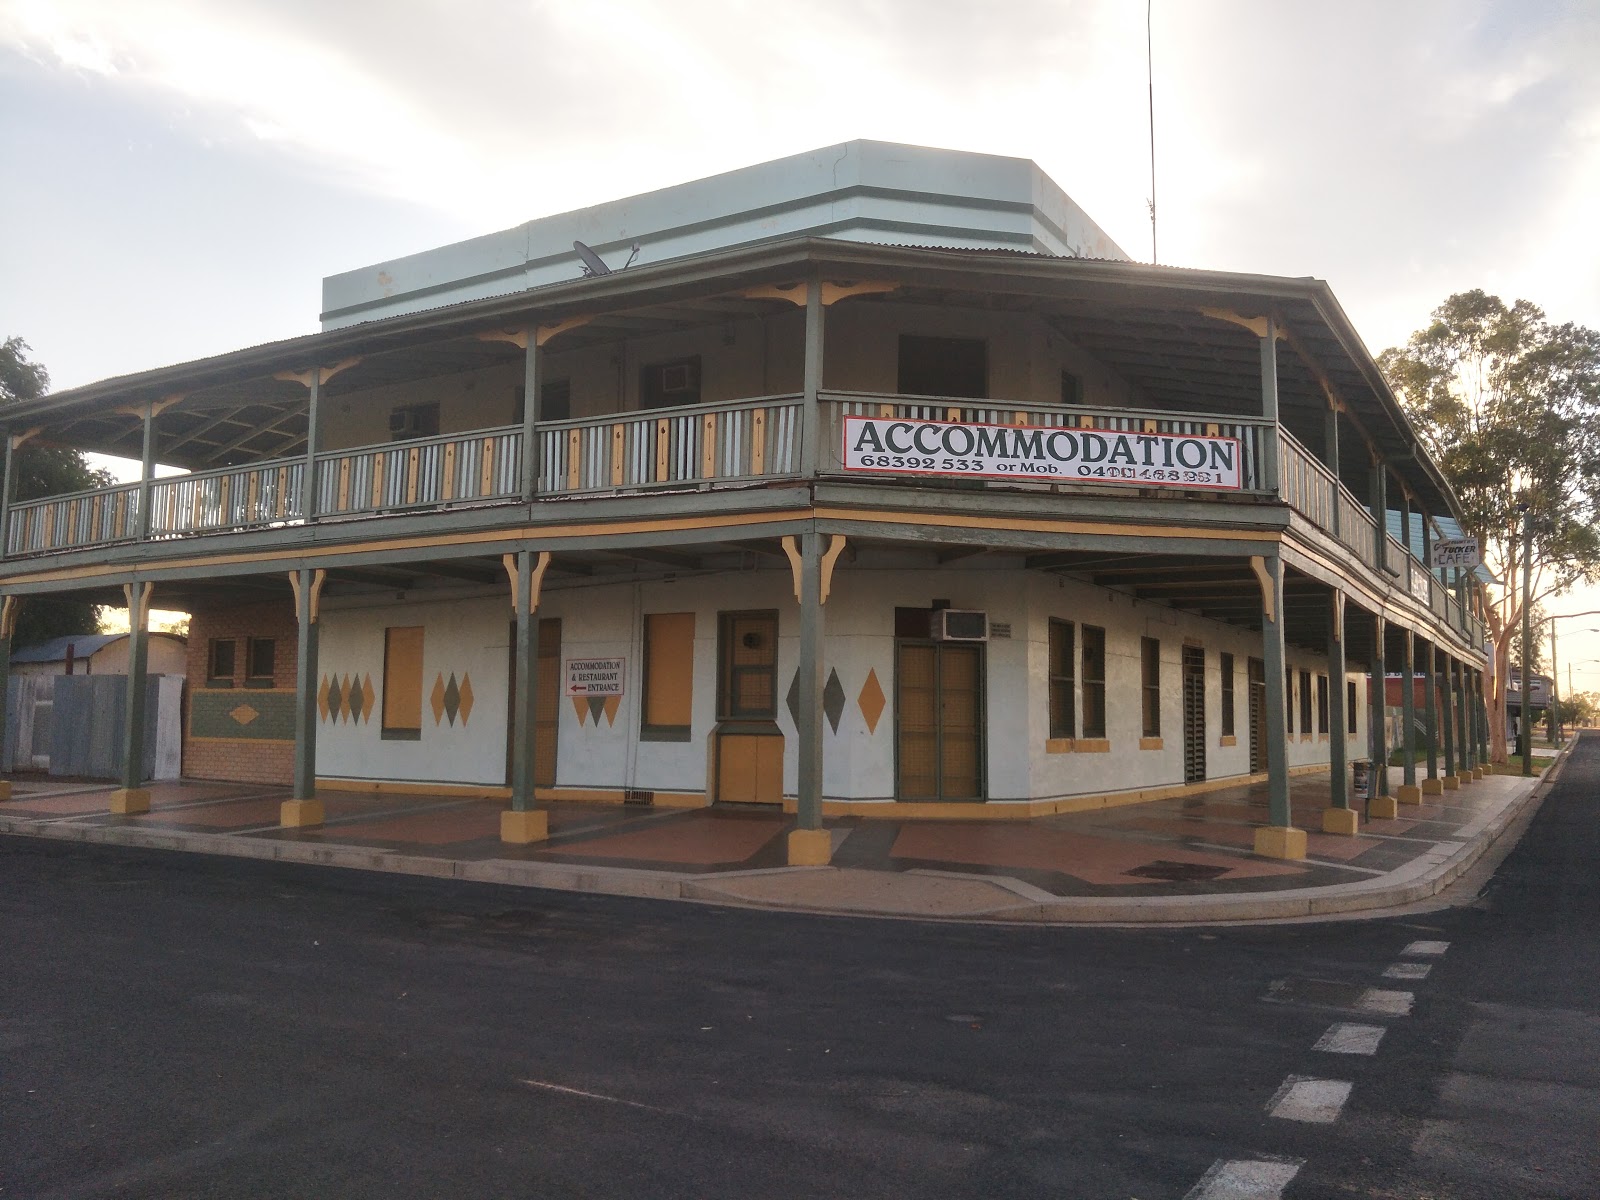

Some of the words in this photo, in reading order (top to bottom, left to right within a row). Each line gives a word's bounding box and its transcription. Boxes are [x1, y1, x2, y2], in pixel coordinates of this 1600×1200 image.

[853, 421, 1234, 471] ACCOMMODATION
[860, 455, 936, 470] 68392
[941, 458, 984, 472] 533
[996, 463, 1017, 472] or
[1019, 462, 1063, 474] Mob.
[1443, 545, 1476, 554] TUCKER
[570, 661, 620, 671] ACCOMMODATION
[571, 673, 577, 681] &
[579, 672, 618, 681] RESTAURANT
[588, 683, 620, 692] ENTRANCE
